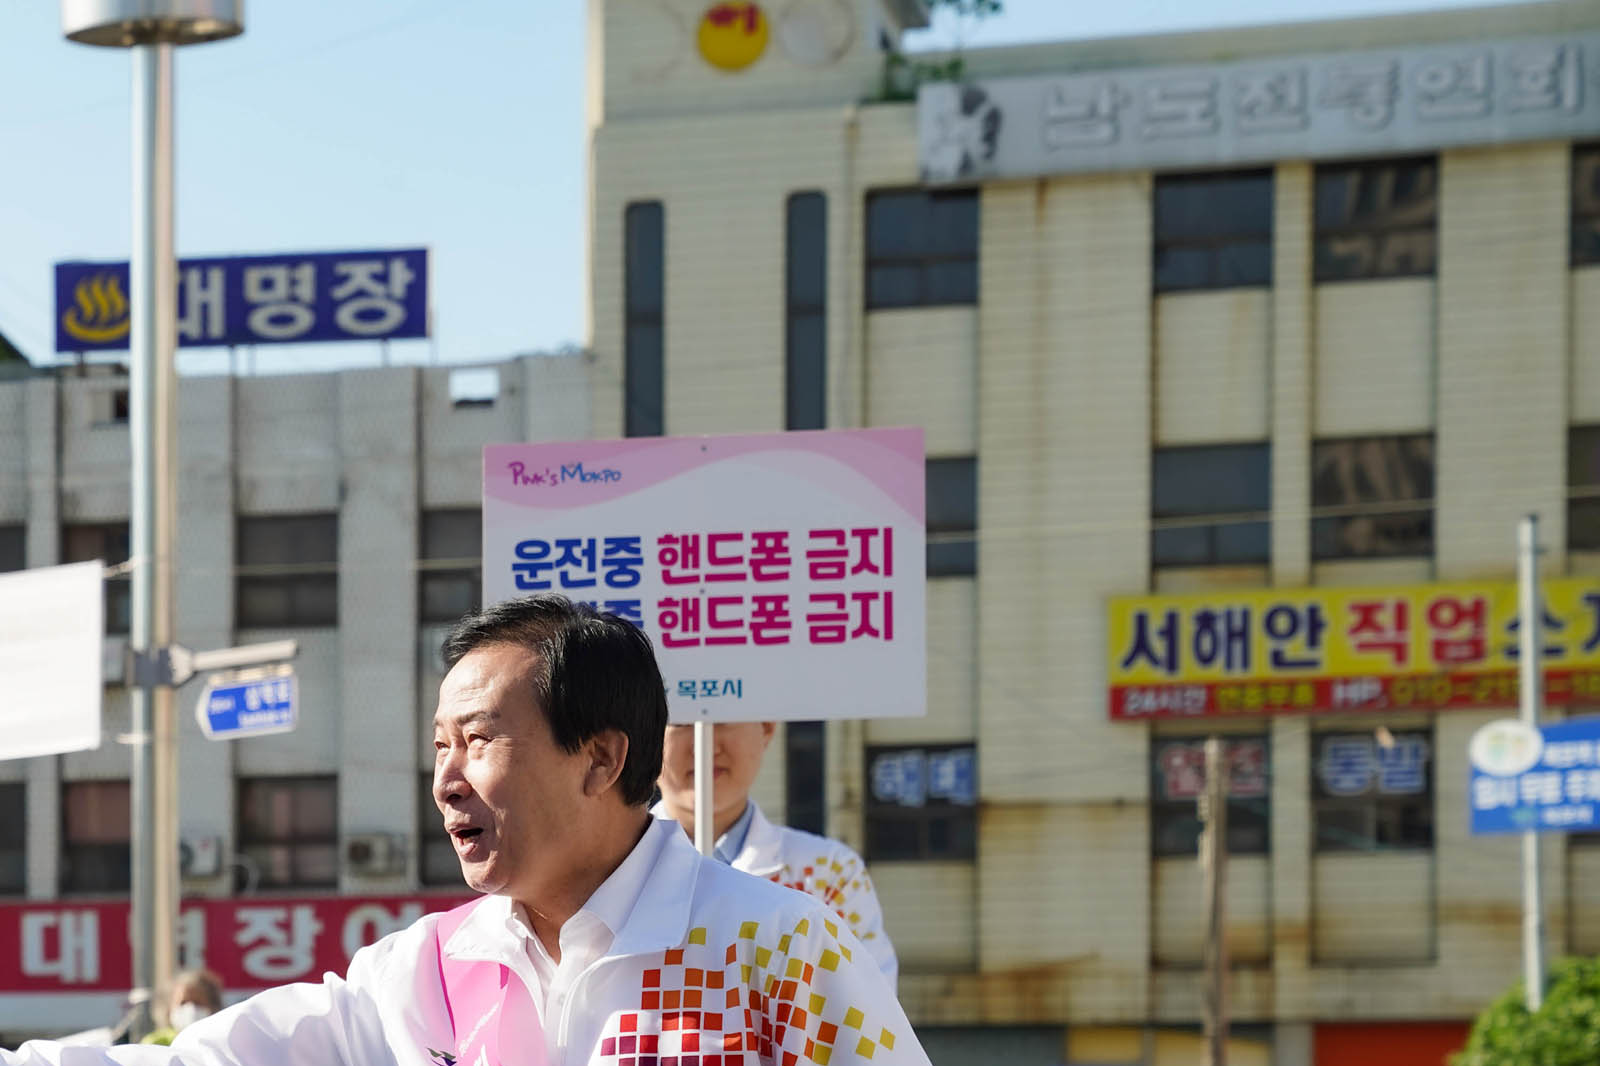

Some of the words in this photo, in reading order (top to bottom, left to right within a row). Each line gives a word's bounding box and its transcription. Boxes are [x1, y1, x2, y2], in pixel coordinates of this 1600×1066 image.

[512, 535, 644, 590] 운전중
[657, 531, 792, 585] 핸드폰
[805, 527, 894, 580] 금지
[657, 594, 792, 648] 핸드폰
[805, 590, 894, 644] 금지
[1121, 604, 1326, 675] 서해안
[677, 678, 743, 700] 목포시
